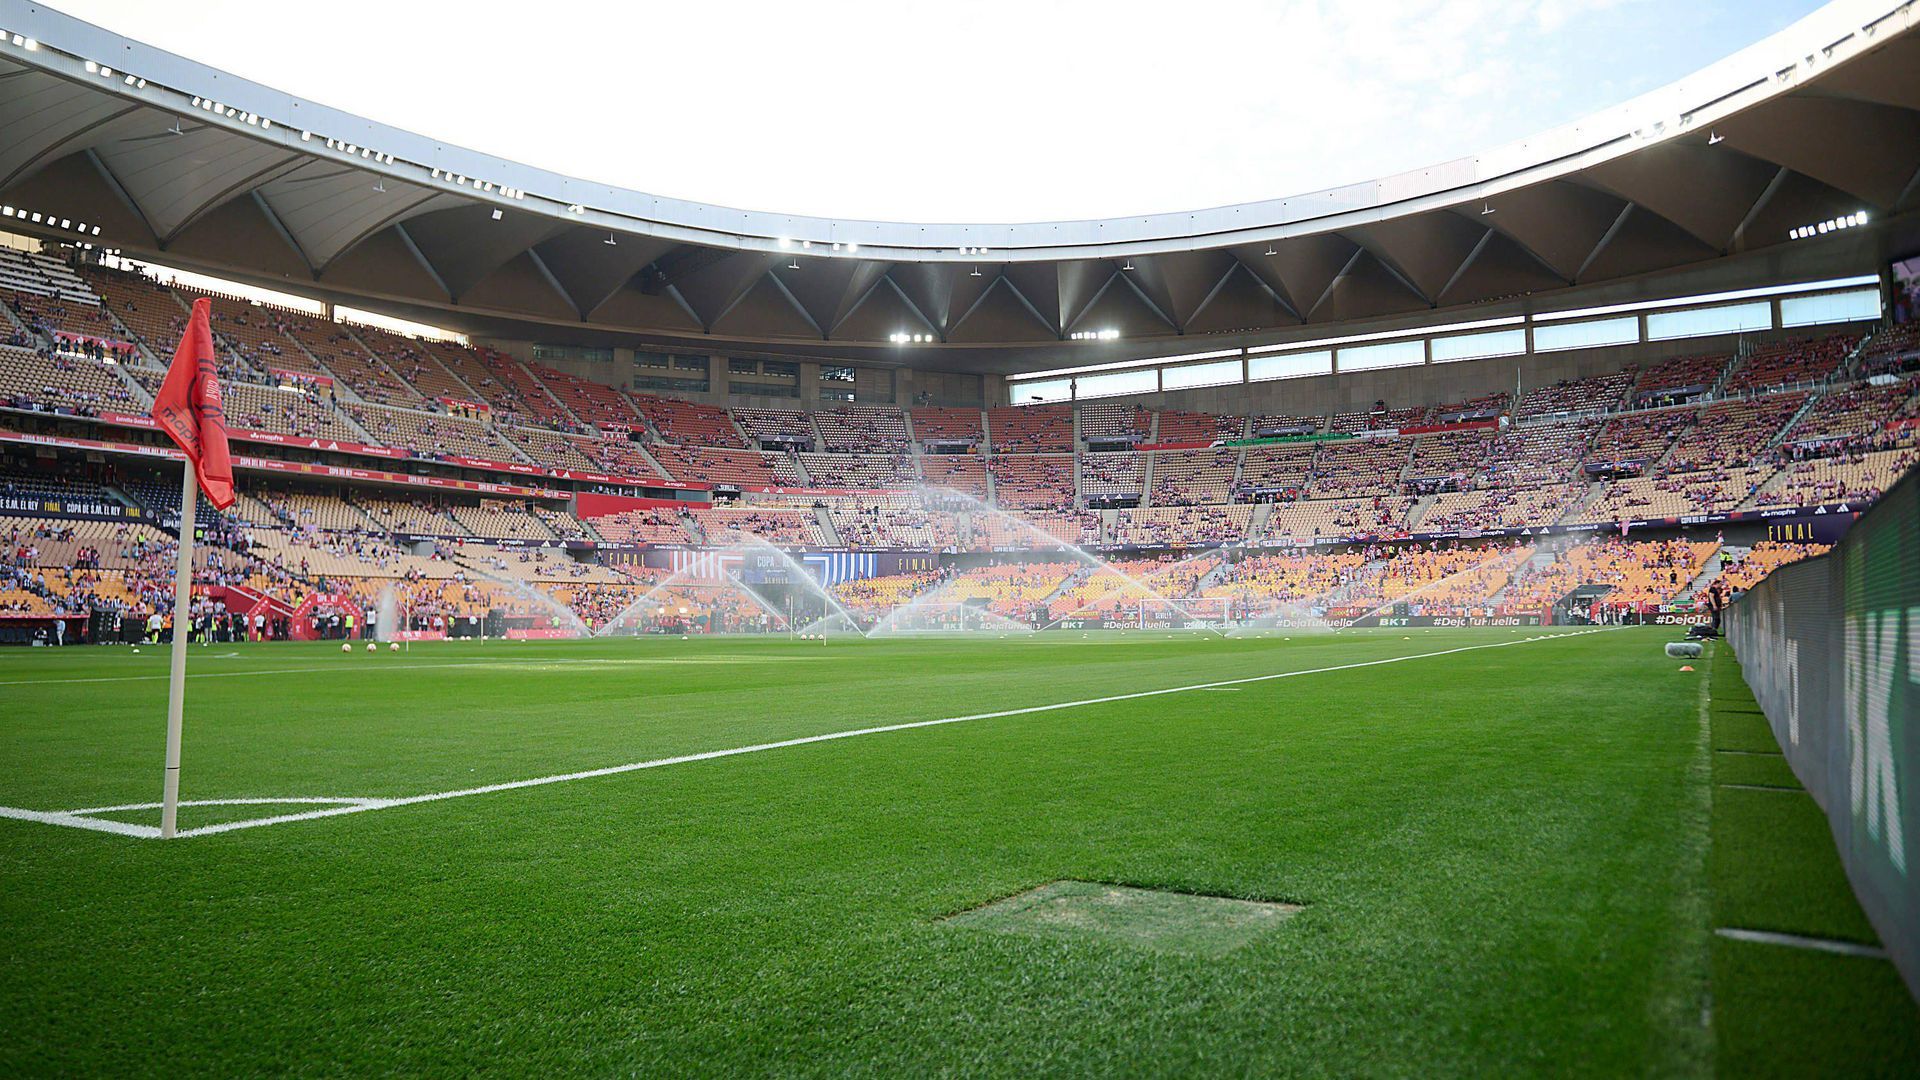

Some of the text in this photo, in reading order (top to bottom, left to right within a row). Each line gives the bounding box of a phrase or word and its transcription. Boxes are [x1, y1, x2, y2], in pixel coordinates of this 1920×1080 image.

[259, 434, 284, 442] mapfre
[20, 500, 27, 510] EL
[27, 501, 39, 511] REY
[44, 501, 61, 513] FINAL
[66, 503, 82, 514] COPA
[82, 504, 89, 514] DE
[103, 505, 110, 516] EL
[110, 506, 121, 517] REY
[125, 507, 141, 518] FINAL
[1771, 508, 1796, 516] mapfre
[1768, 523, 1814, 541] FINAL
[609, 552, 645, 567] FINAL
[757, 555, 775, 568] COPA
[898, 558, 933, 571] FINAL
[1060, 621, 1085, 629] BKT
[1275, 618, 1354, 629] #DejaTuHuella
[1379, 618, 1409, 626] BKT
[1655, 613, 1713, 625] #DejaTu
